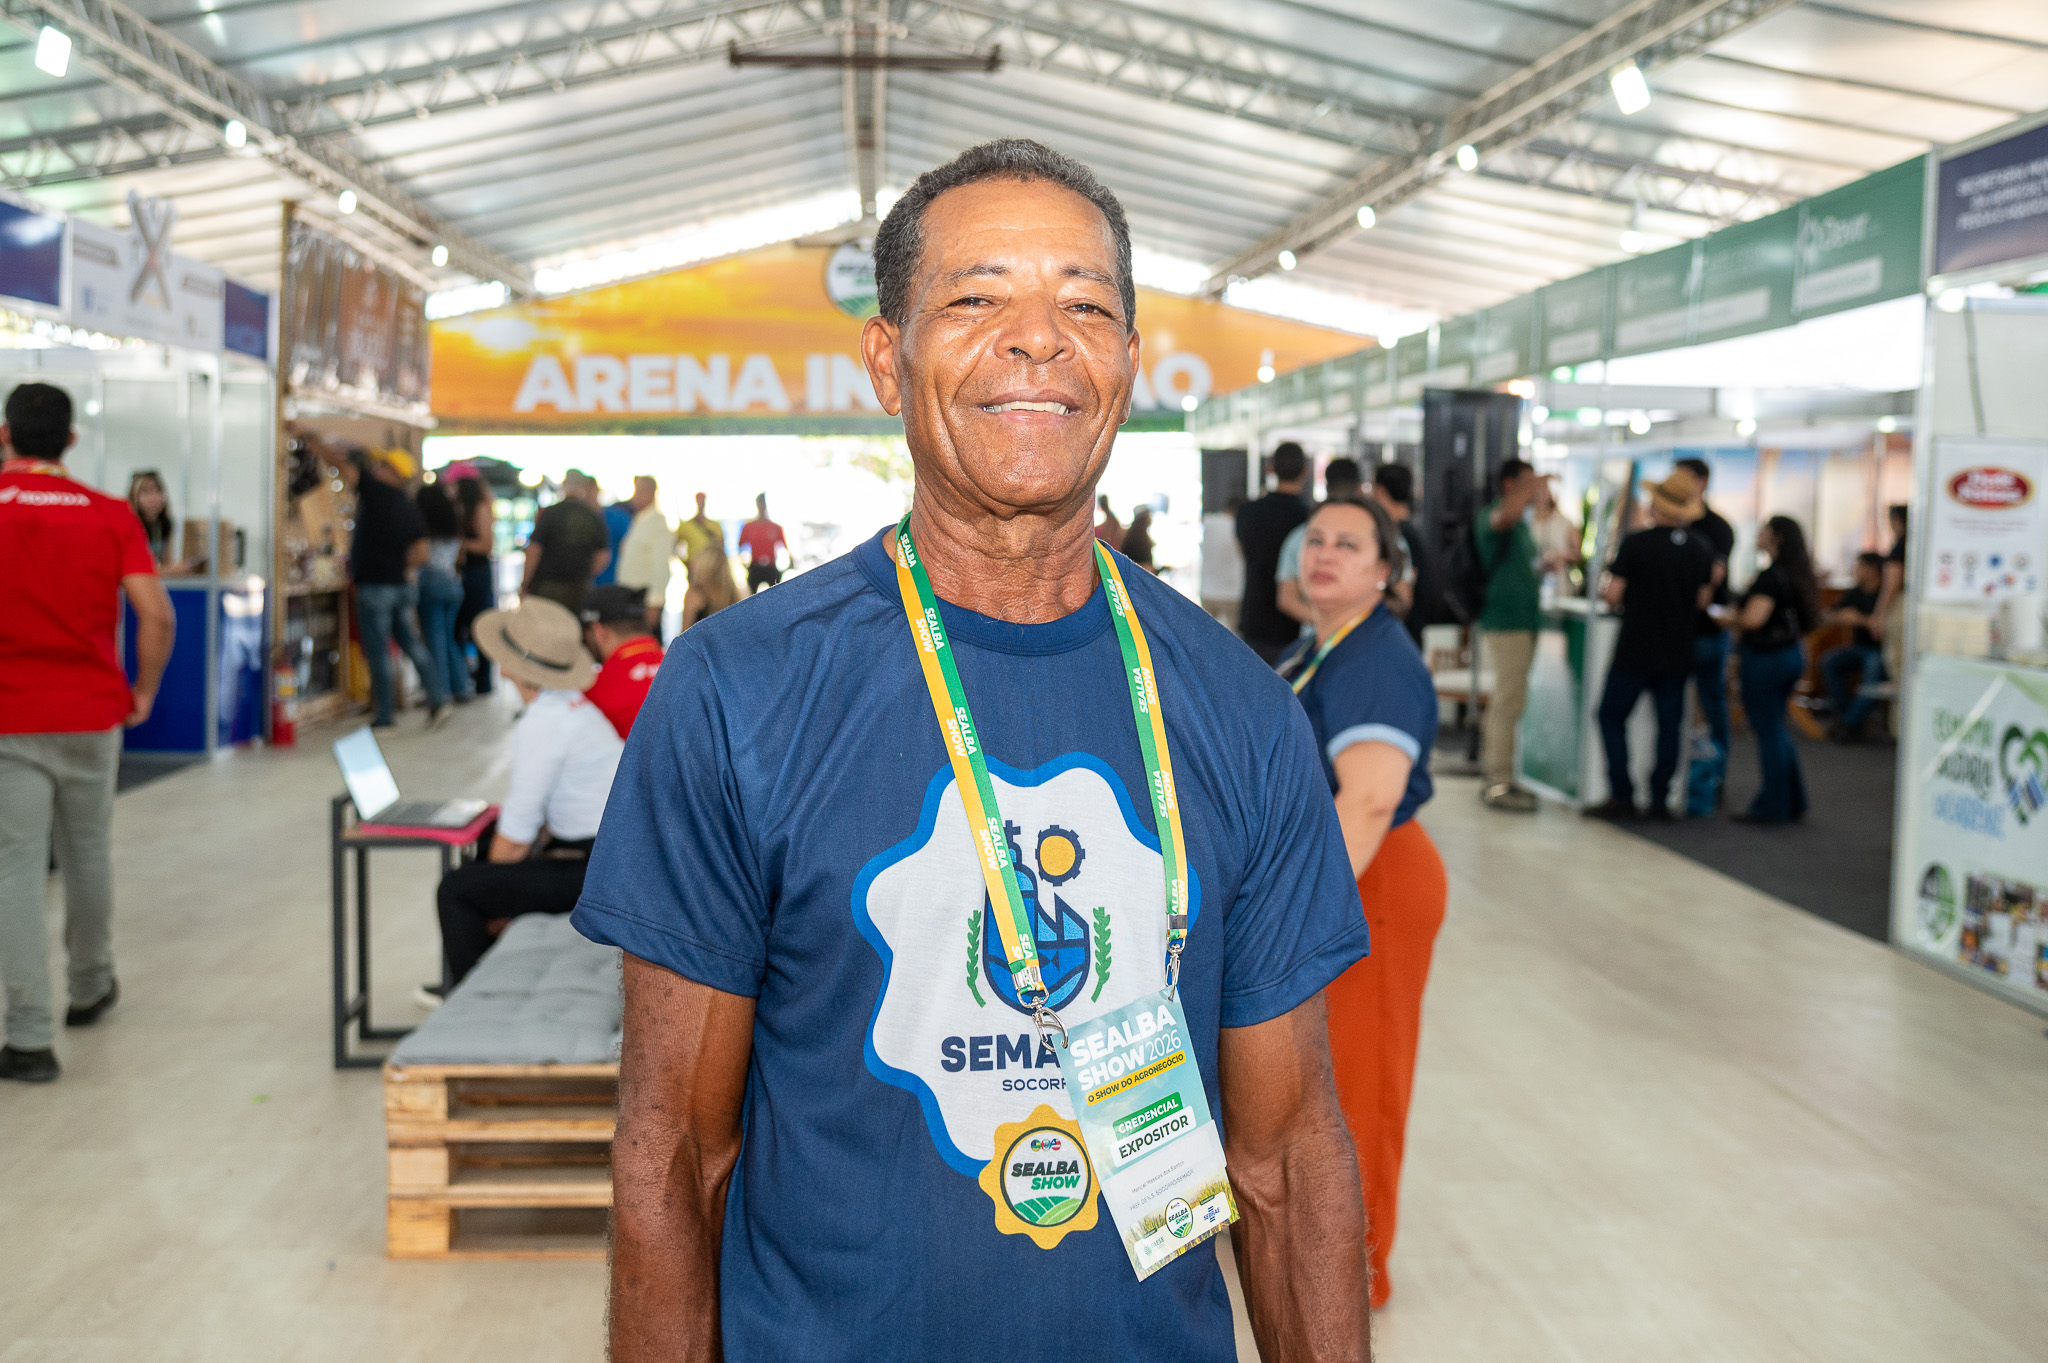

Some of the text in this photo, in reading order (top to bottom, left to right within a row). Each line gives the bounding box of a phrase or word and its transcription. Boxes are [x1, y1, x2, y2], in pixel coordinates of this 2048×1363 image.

[514, 353, 791, 413] ARENA
[900, 533, 917, 568] SEALBA
[1107, 578, 1126, 618] SEALBA
[1114, 579, 1131, 611] SHOW
[916, 618, 934, 652] SHOW
[924, 608, 945, 650] SEALBA
[1132, 667, 1148, 714] SEALBA
[1141, 666, 1156, 705] SHOW
[946, 718, 967, 758] SHOW
[955, 706, 977, 755] SEALBA
[1153, 770, 1168, 818] SEALBA
[1160, 769, 1175, 810] SHOW
[979, 828, 999, 871] SHOW
[987, 816, 1008, 869] SEALBA
[940, 1034, 1060, 1072] SEMA
[1070, 1004, 1176, 1067] SEALBA
[1078, 1030, 1182, 1091] SHOW 2026
[1088, 1054, 1184, 1102] O SHOW DO AGRONEGÓCIO
[1118, 1098, 1179, 1134] CREDENCIAL
[1118, 1114, 1189, 1159] EXPOSITOR
[1011, 1160, 1080, 1177] SEALBA
[1031, 1175, 1081, 1190] SHOW
